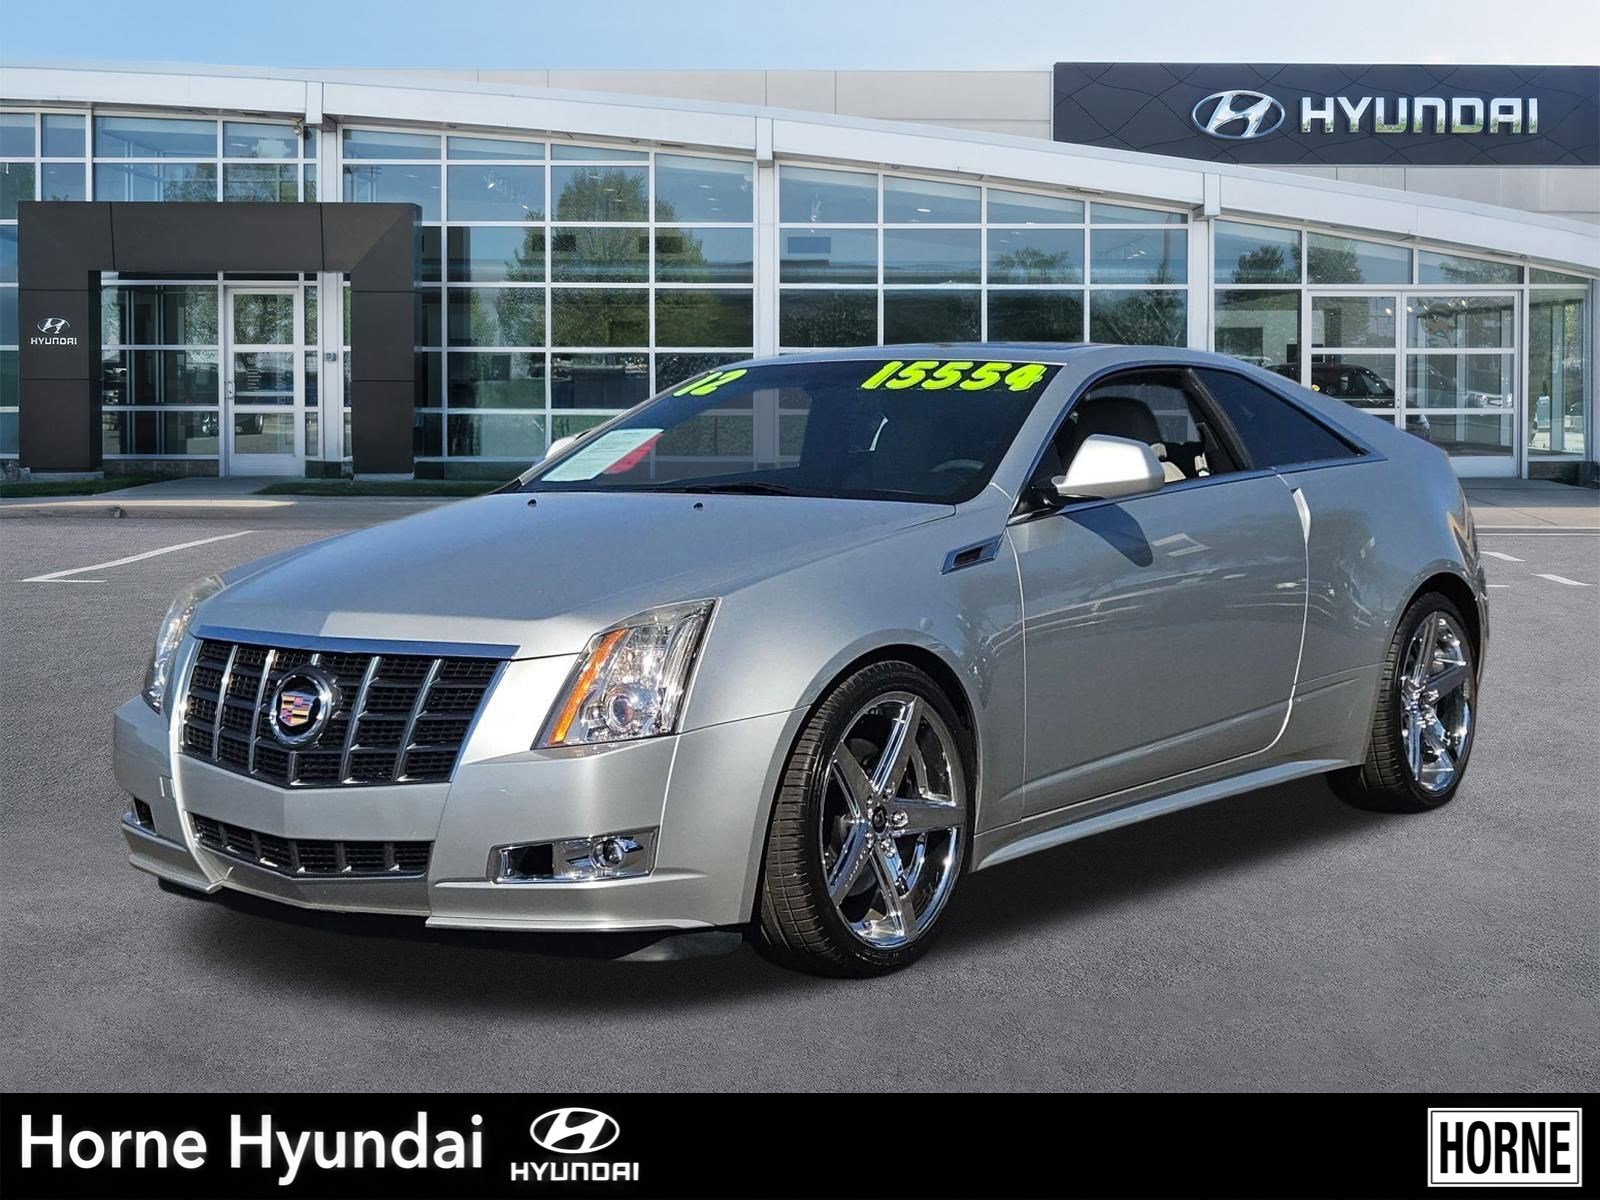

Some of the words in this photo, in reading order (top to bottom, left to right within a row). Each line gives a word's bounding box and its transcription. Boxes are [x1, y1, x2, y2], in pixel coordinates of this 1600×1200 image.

[1300, 97, 1539, 134] HYUNDAI
[31, 337, 77, 345] HYUNDAI
[672, 368, 748, 397] 12
[860, 360, 1047, 392] 15554
